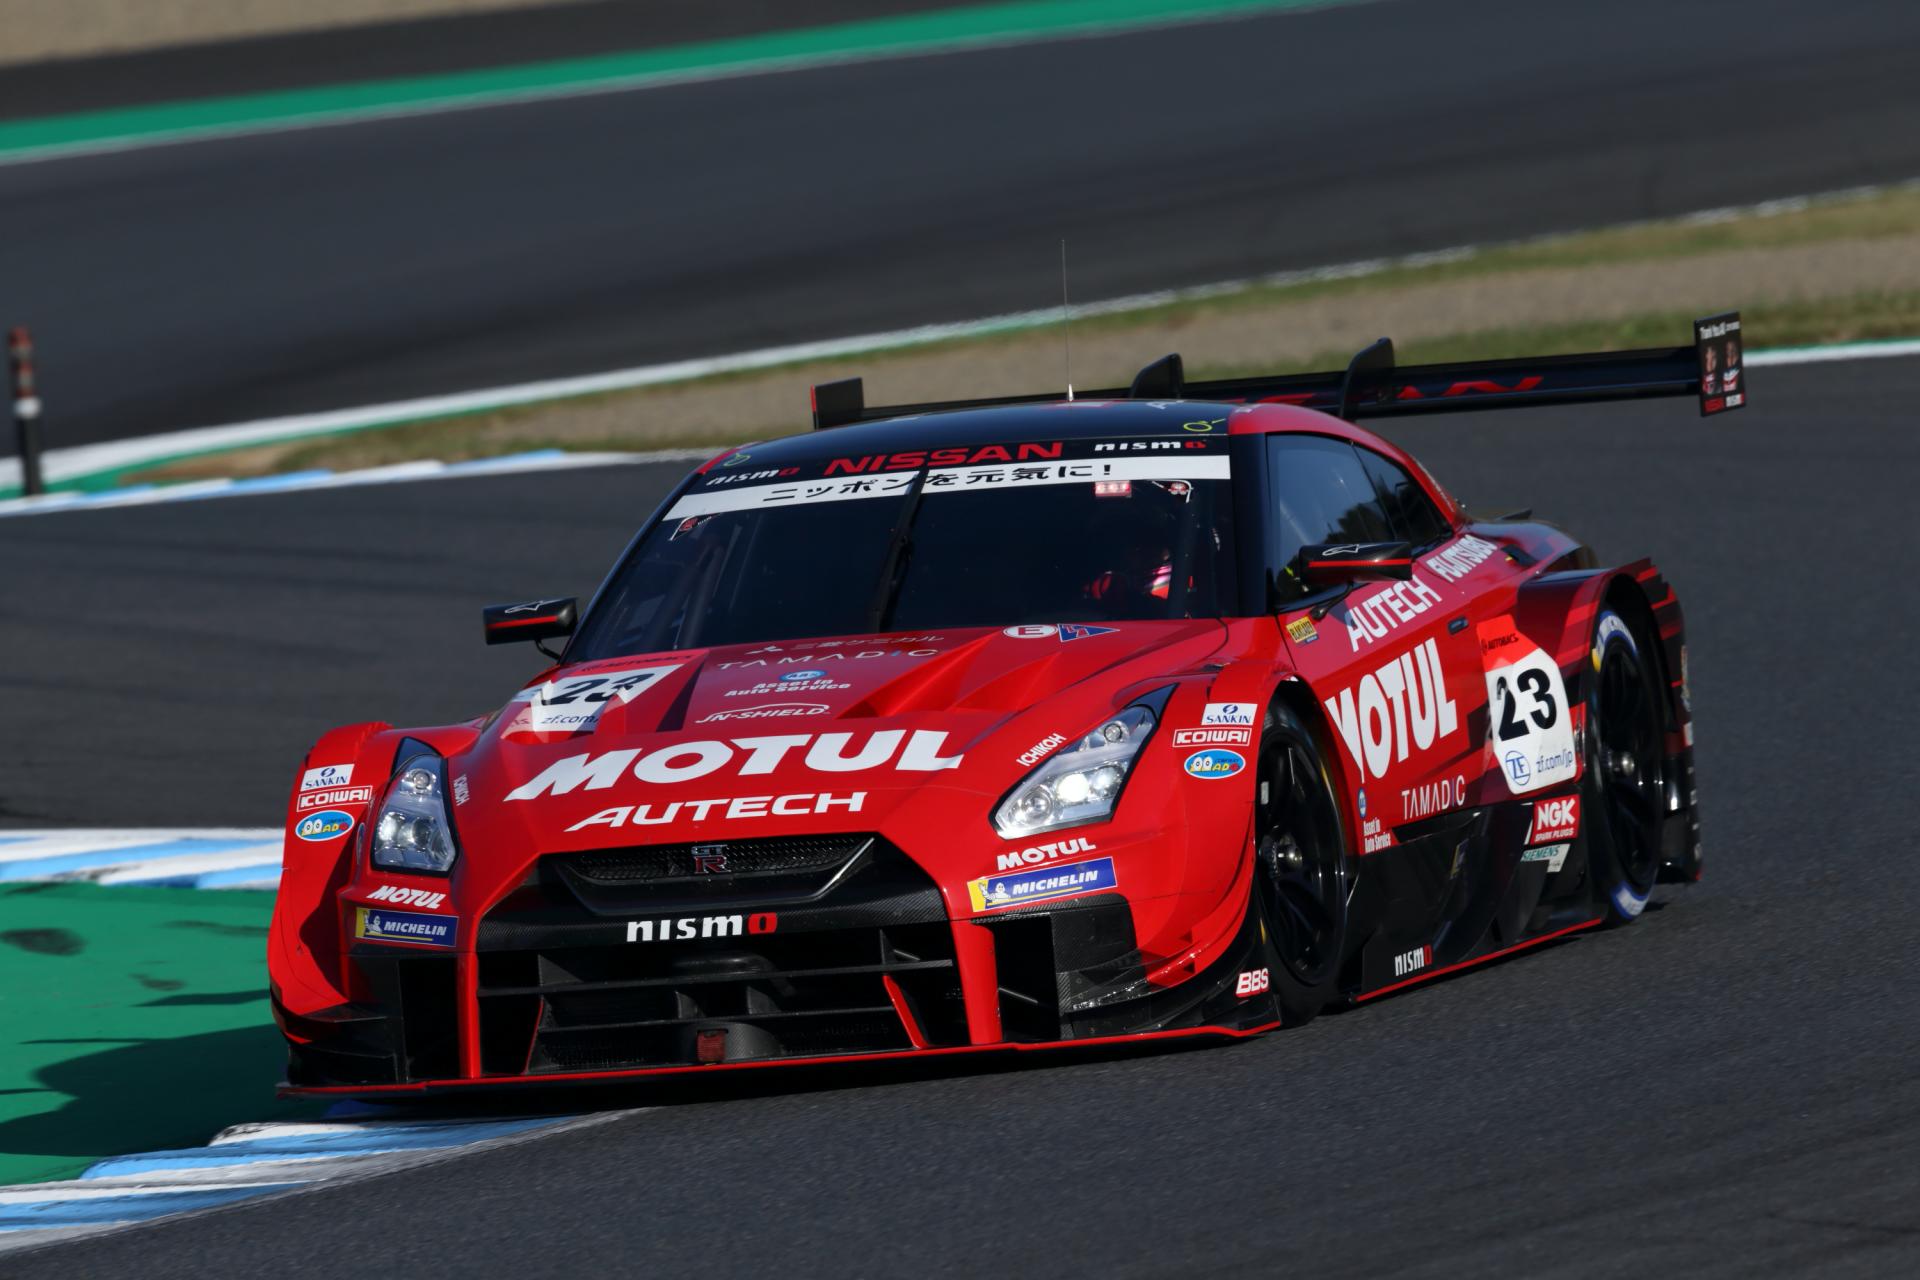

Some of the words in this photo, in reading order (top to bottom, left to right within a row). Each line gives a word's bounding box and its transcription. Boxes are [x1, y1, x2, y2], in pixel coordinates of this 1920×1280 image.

[823, 442, 1063, 476] NISSAN
[1094, 440, 1207, 452] nismo
[706, 466, 801, 486] nismo
[1347, 574, 1443, 653] AUTECH
[717, 648, 940, 670] TAMADIC
[539, 673, 656, 706] 23
[1496, 668, 1557, 742] 23
[1206, 715, 1251, 724] SANKIN
[502, 729, 965, 801] MOTUL
[1016, 732, 1067, 767] ICHIKOH
[304, 776, 348, 788] SANKIN
[1401, 774, 1466, 821] TAMADIC
[563, 791, 868, 832] AUTECH
[1536, 798, 1576, 831] NGK
[1552, 827, 1575, 839] PLUGS
[996, 837, 1097, 871] MOTUL
[1522, 845, 1561, 861] SIEMENS
[366, 885, 447, 909] MOTUL
[1012, 870, 1098, 895] MICHELIN
[383, 920, 447, 936] MICHELIN
[626, 911, 778, 943] nismo
[1394, 944, 1433, 976] nismo
[1235, 967, 1270, 995] BBS
